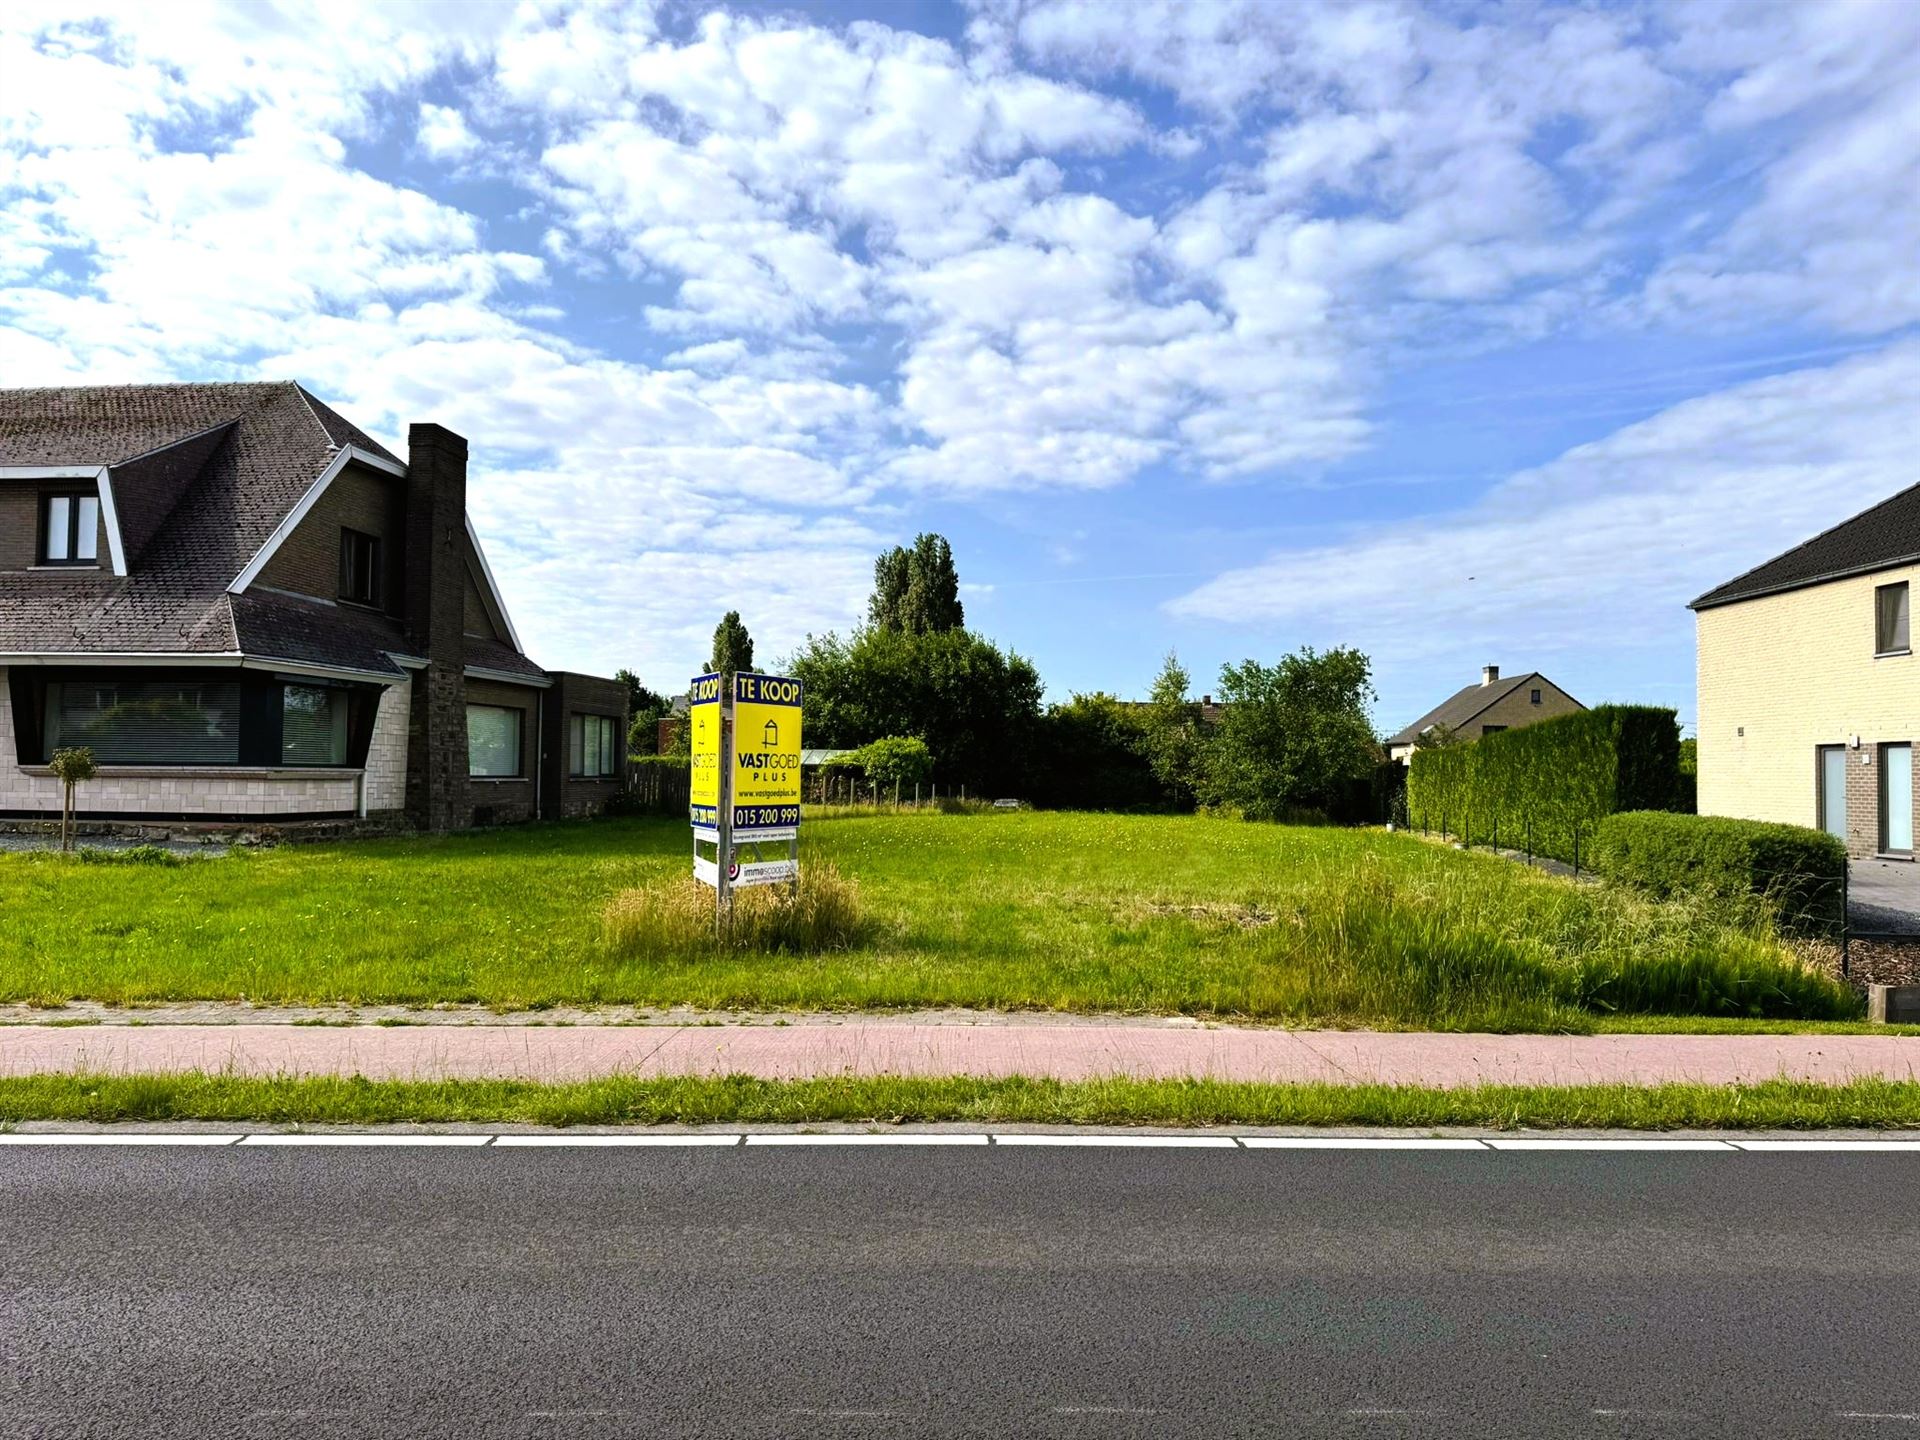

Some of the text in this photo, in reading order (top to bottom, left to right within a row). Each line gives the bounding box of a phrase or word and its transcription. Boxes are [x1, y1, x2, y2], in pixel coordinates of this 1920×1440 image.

[699, 678, 718, 700] KOOP
[740, 678, 799, 702] TE KOOP
[738, 753, 799, 769] VASTGOED
[753, 772, 787, 782] PLUS
[738, 788, 797, 799] www.vastgoedplus.be
[736, 808, 798, 825] 015 200 999
